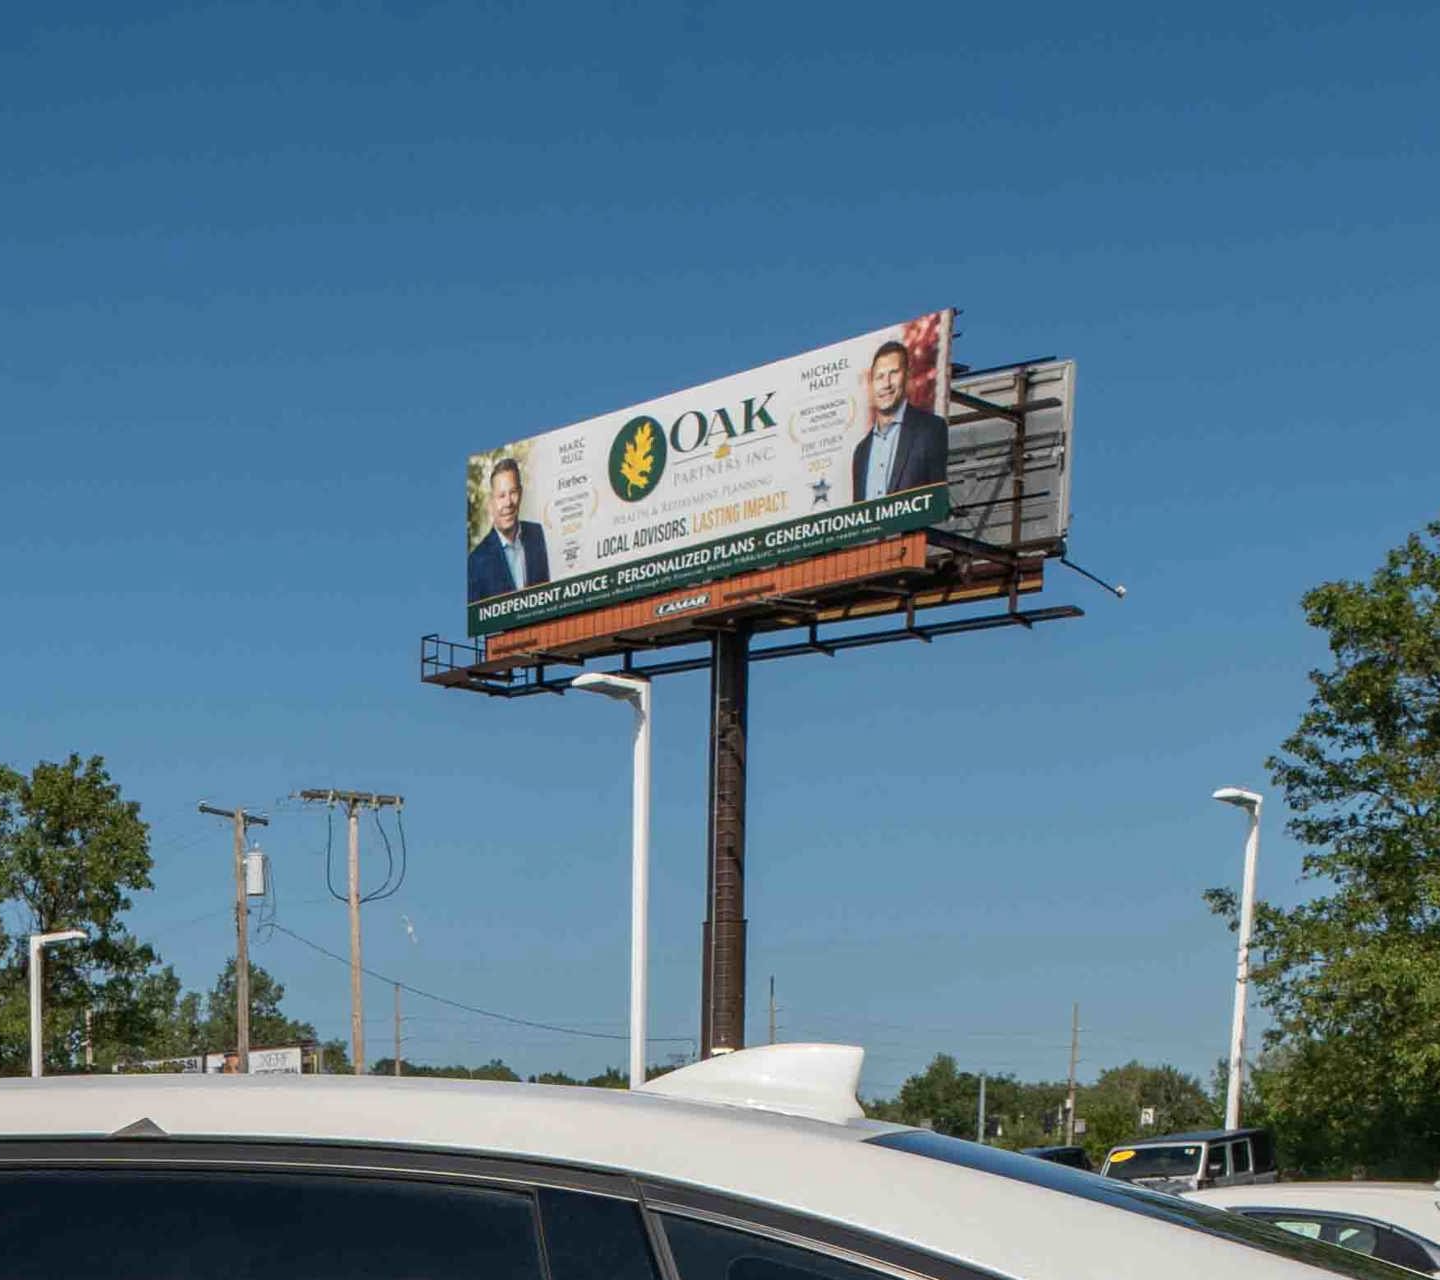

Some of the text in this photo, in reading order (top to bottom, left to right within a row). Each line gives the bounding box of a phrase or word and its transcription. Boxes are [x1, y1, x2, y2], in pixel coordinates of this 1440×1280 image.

[801, 358, 850, 383] MICHAEL
[809, 373, 840, 393] HADT
[671, 391, 777, 453] OAK
[673, 457, 741, 487] PARTNERS
[596, 533, 630, 560] LOCAL
[633, 516, 689, 547] ADVISORS.
[693, 500, 741, 533] LASTING
[479, 587, 561, 622] INDEPENDENT
[563, 574, 608, 599] ADVICE
[617, 548, 710, 586] PERSONALIZED
[713, 536, 755, 557] PLANS
[764, 509, 873, 548] GENERATIONAL
[875, 494, 933, 522] IMPACT
